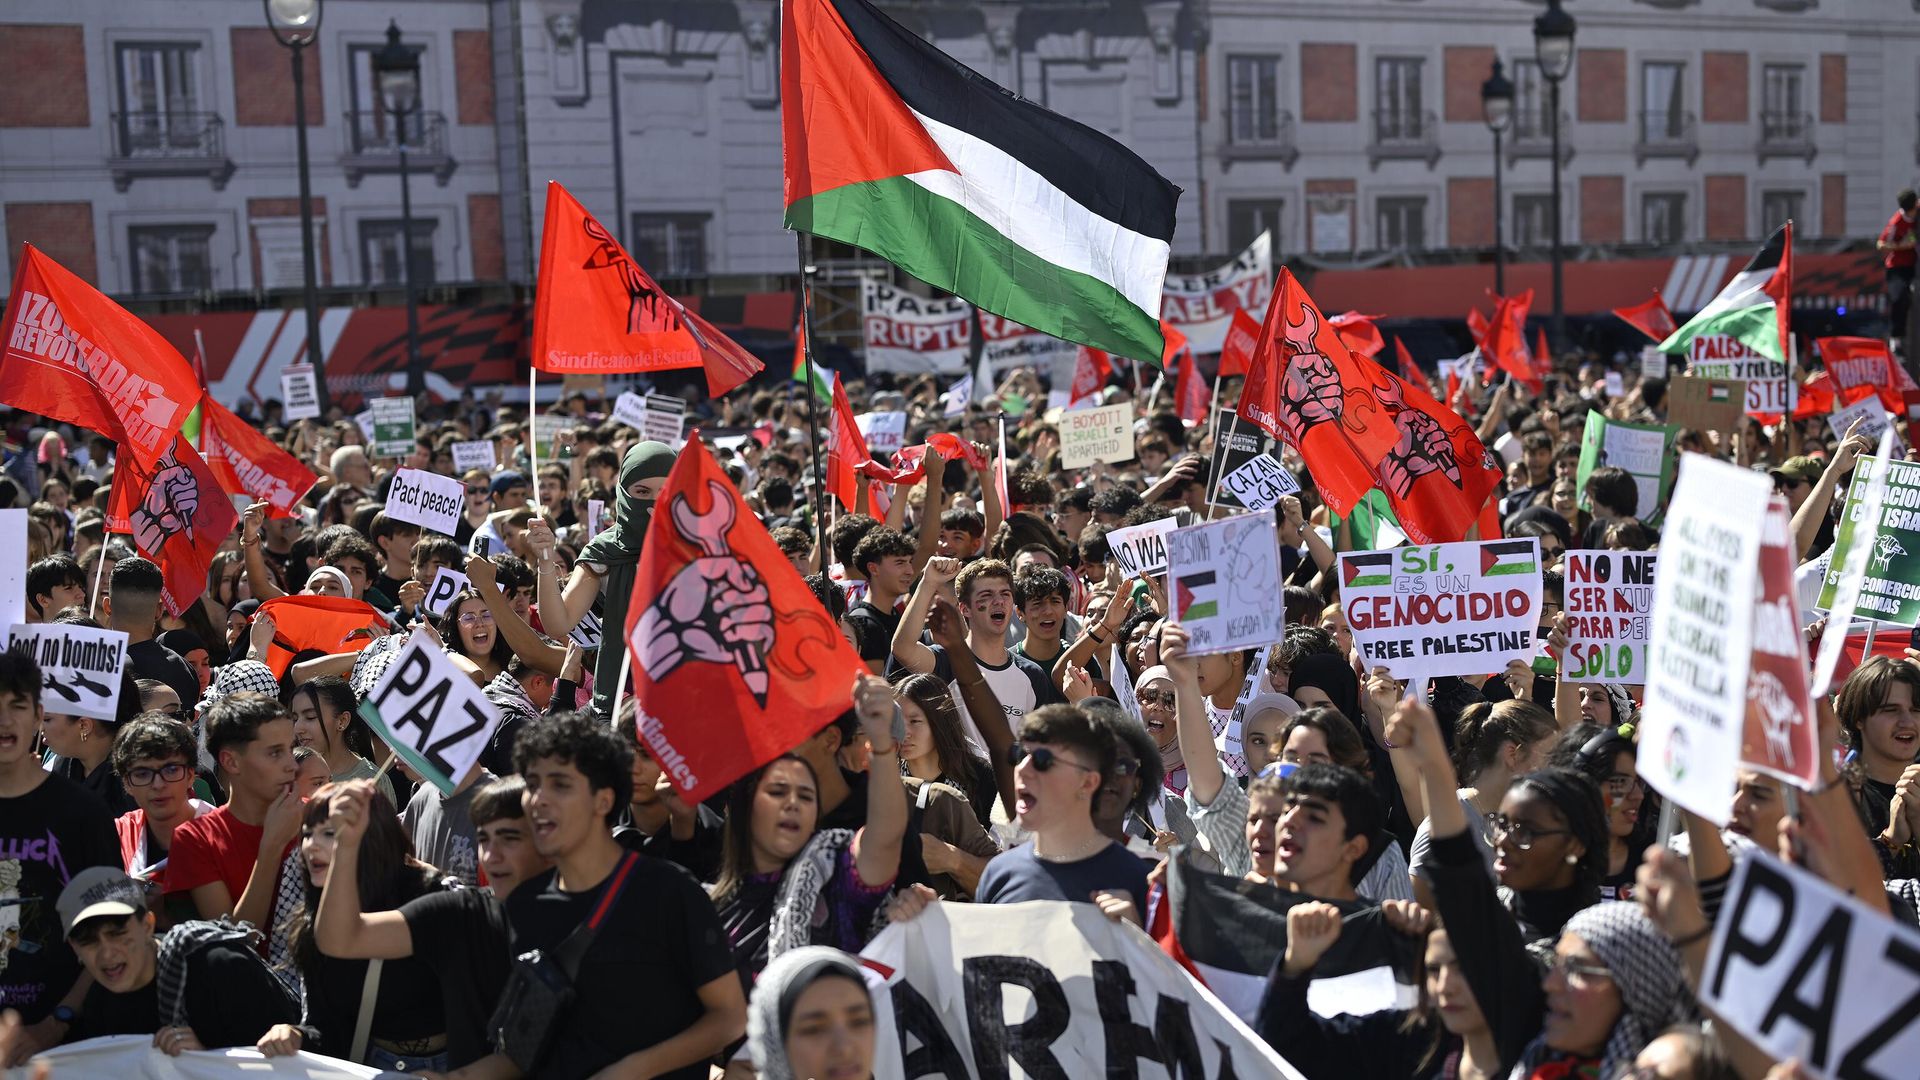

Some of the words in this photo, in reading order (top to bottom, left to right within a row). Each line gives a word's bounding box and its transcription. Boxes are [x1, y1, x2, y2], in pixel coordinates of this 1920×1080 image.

[548, 350, 633, 369] Sindicato
[635, 351, 652, 367] de
[1072, 410, 1121, 430] BOYCOTT
[1064, 427, 1109, 444] ISRAELI
[1067, 439, 1120, 460] APARTHEID
[1220, 441, 1258, 454] VNCERA
[1227, 455, 1281, 495] CAZAN
[1257, 470, 1300, 501] GAZA!
[391, 475, 421, 506] Pact
[419, 490, 463, 518] peace!
[1249, 498, 1266, 511] en
[1111, 541, 1138, 574] NO
[1401, 545, 1455, 574] SÍ,
[1569, 554, 1612, 584] NO
[1393, 575, 1428, 595] ES
[1435, 573, 1471, 593] UN
[1859, 575, 1920, 602] COMERCIO
[1347, 588, 1531, 631] GENOCIDIO
[1568, 586, 1608, 613] SER
[1613, 587, 1656, 614] MU
[1857, 593, 1902, 615] ARMAS
[1567, 615, 1615, 639] PARA
[40, 635, 58, 668] no
[63, 632, 124, 675] bombs!
[1362, 639, 1416, 660] FREE
[1422, 630, 1531, 656] PALESTINE
[1568, 642, 1633, 679] SOLO
[375, 645, 489, 779] PAZ
